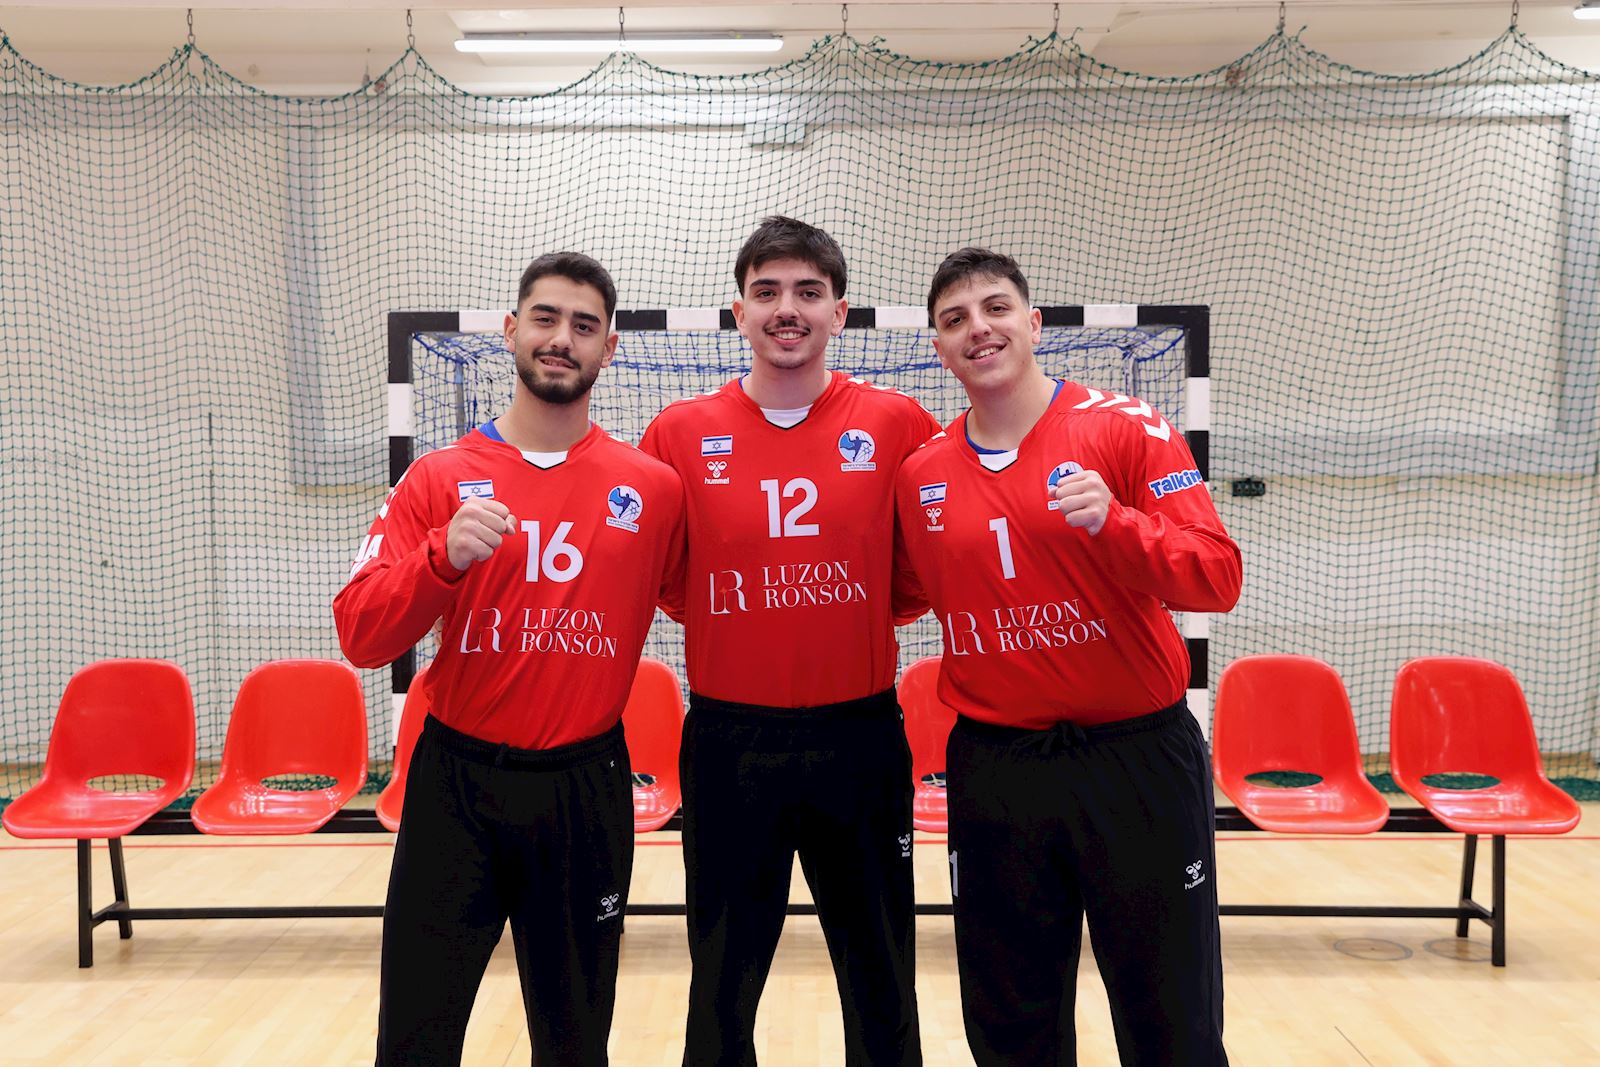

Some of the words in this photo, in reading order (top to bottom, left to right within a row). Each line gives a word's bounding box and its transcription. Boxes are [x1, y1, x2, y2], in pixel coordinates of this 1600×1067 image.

[704, 477, 730, 485] hummel
[760, 477, 820, 538] 12
[521, 520, 584, 583] 16
[989, 517, 1016, 580] 1
[761, 560, 850, 587] LUZON
[763, 582, 867, 609] RONSON
[522, 607, 606, 633] LUZON
[992, 598, 1082, 629] LUZON
[518, 631, 618, 658] RONSON
[997, 618, 1109, 653] RONSON
